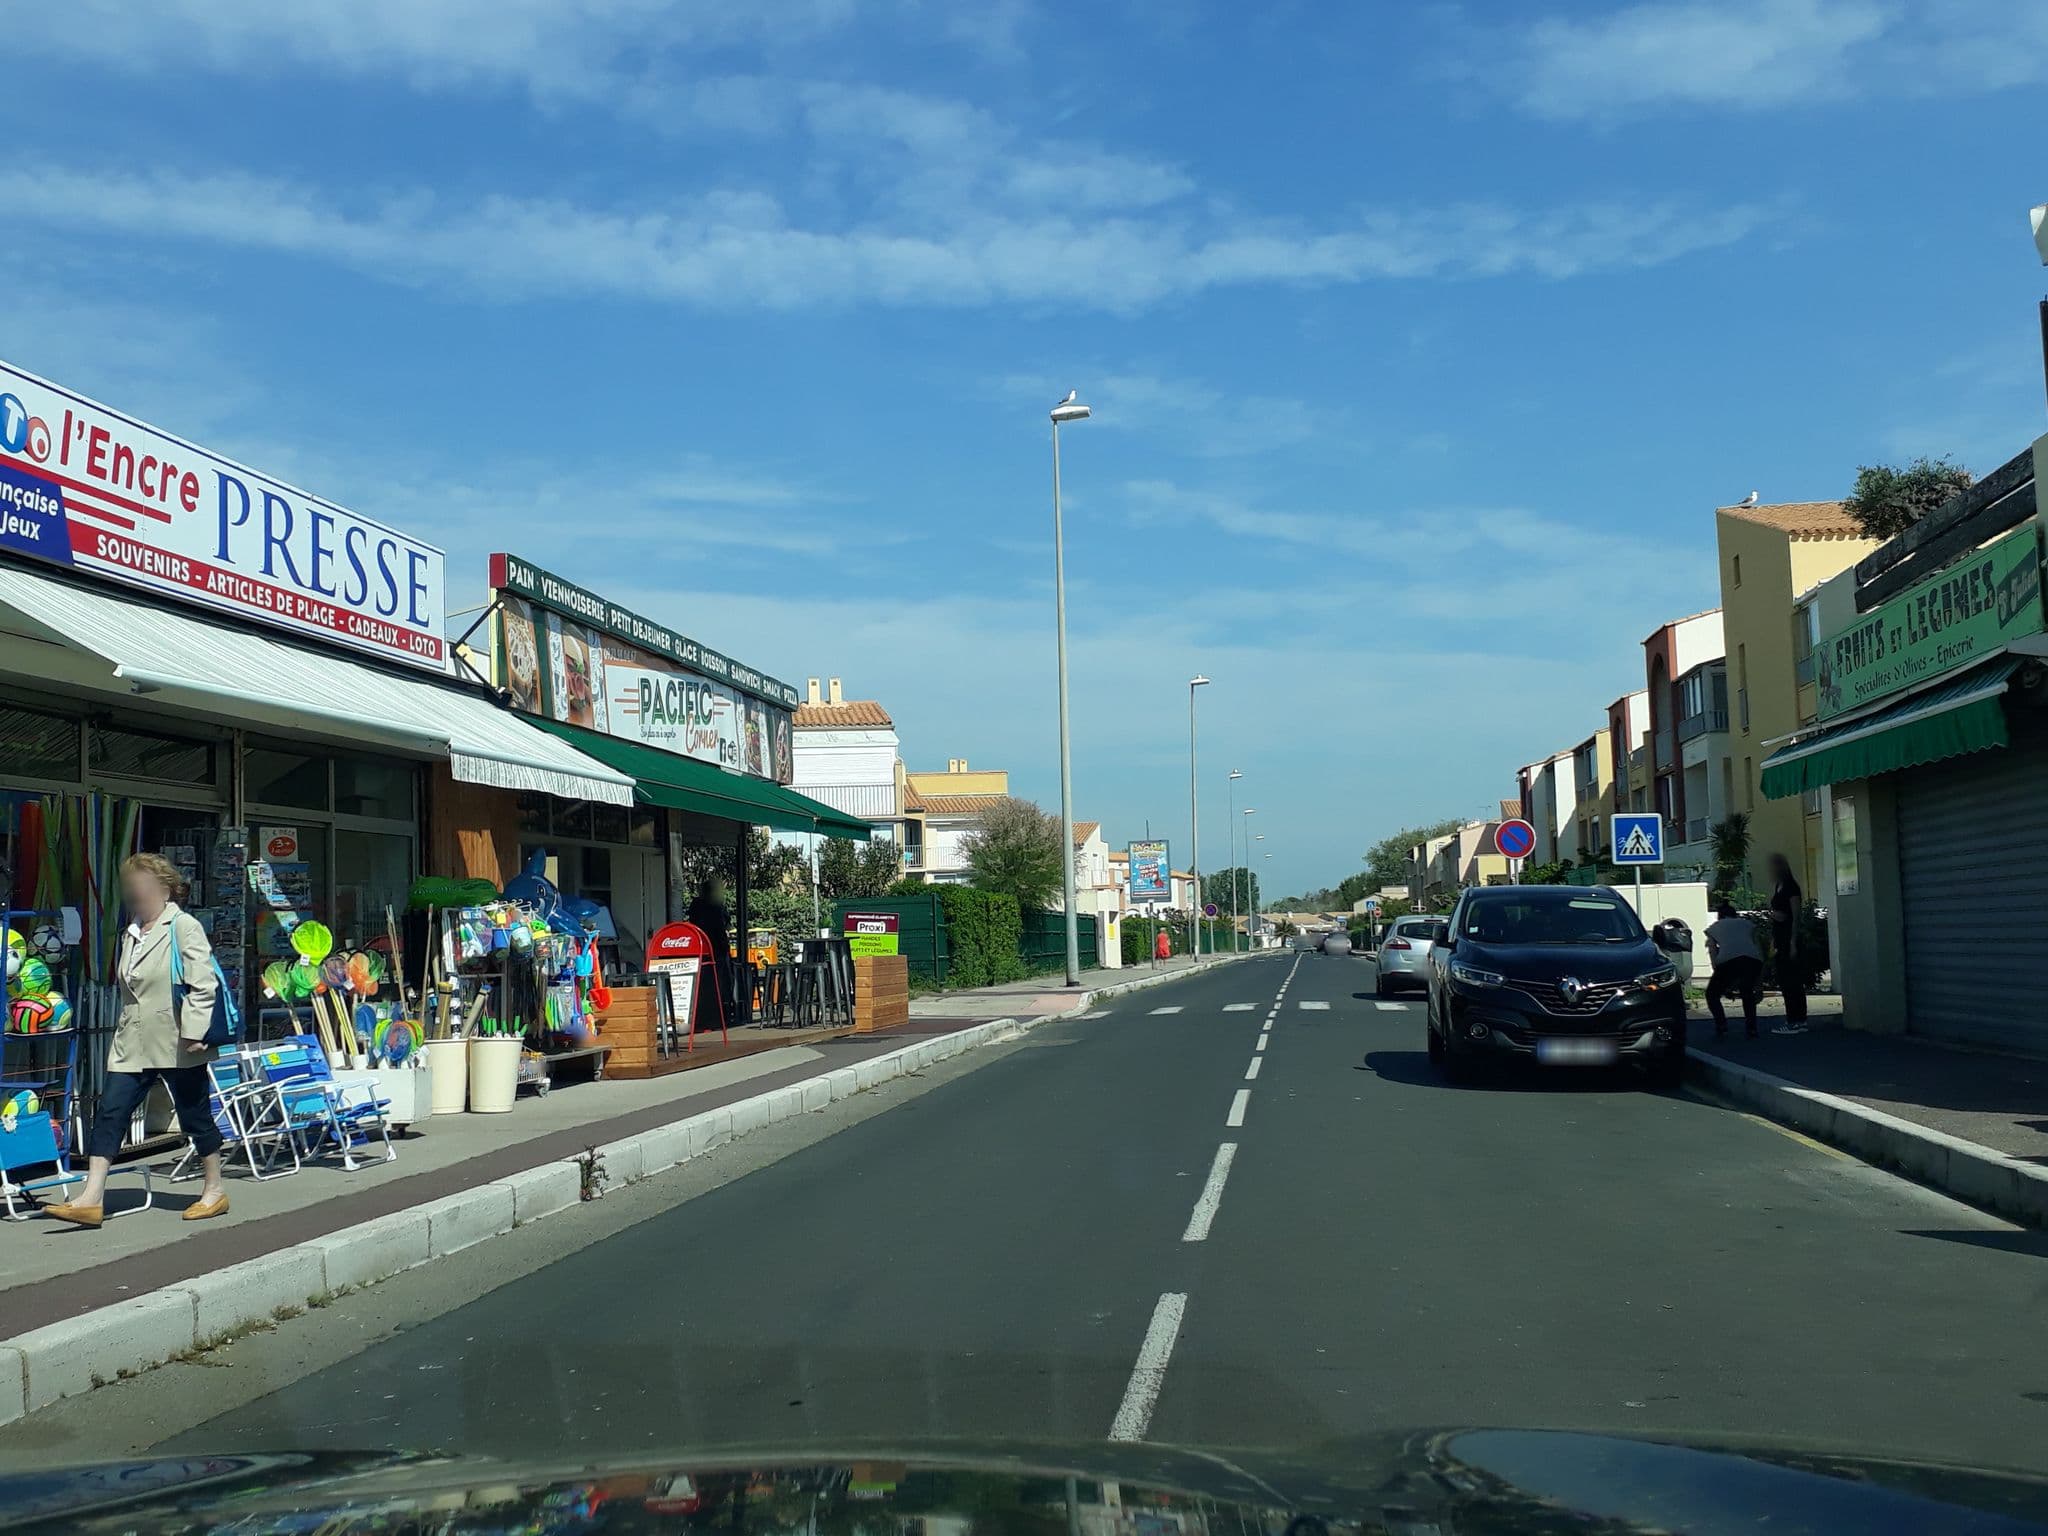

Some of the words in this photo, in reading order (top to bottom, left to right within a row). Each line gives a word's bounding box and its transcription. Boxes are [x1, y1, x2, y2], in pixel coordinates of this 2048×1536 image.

[60, 409, 200, 513] l'Encre
[97, 534, 190, 583] SOUVENIRS
[207, 570, 272, 609] ARTICLES
[276, 592, 293, 614] DE
[298, 596, 336, 627] PLAGE
[348, 615, 398, 646] CADEAUX
[409, 634, 436, 657] LOTO
[212, 469, 430, 629] PRESSE
[509, 561, 534, 591] PAIN
[541, 576, 605, 622] VIENNOISERIE
[611, 609, 632, 634] PETIT
[633, 619, 671, 651] DEJEUNER
[674, 639, 697, 662] GLACE
[1836, 618, 1885, 679] FRUITS
[1907, 560, 1996, 646] LEGUMES
[640, 677, 713, 726] PACIFIC
[686, 712, 719, 754] Corner
[658, 961, 691, 972] PACIFIC
[859, 921, 884, 932] Proxi
